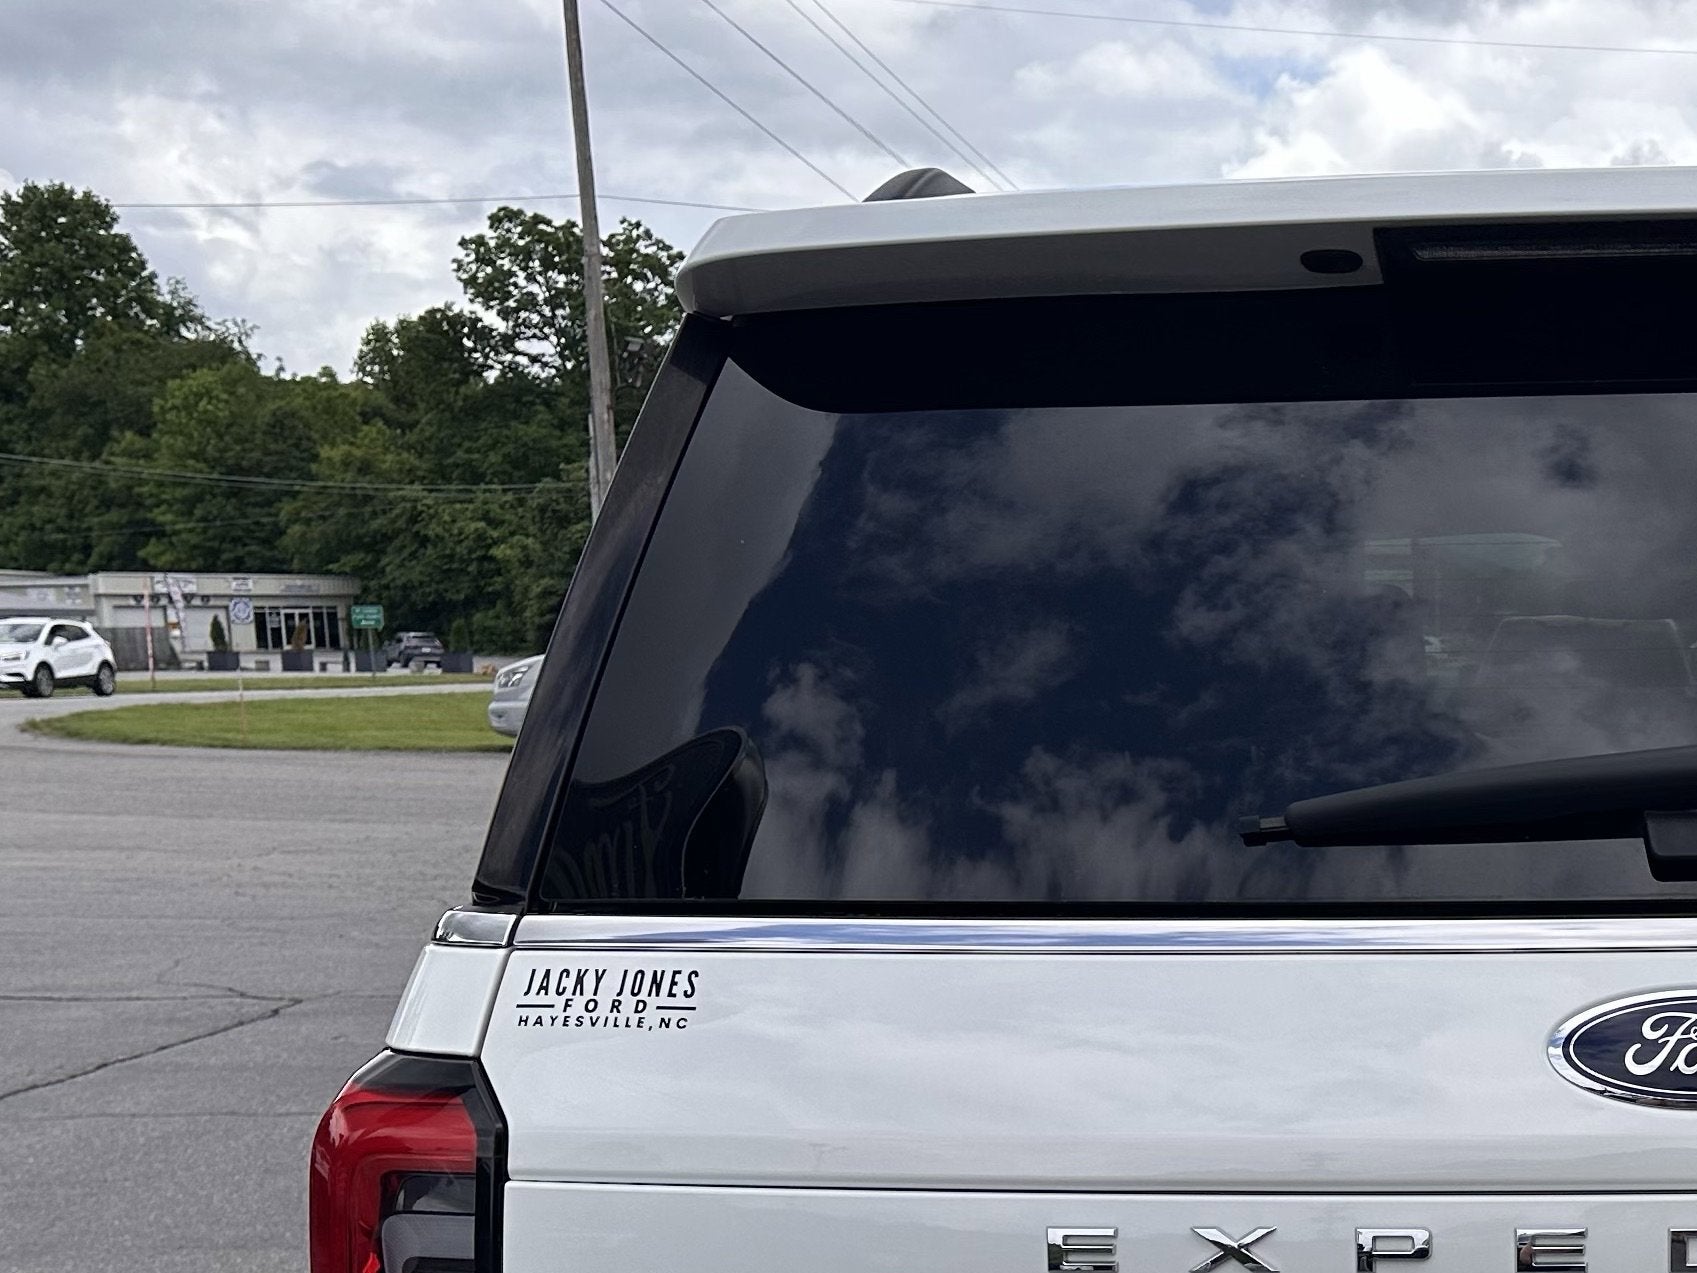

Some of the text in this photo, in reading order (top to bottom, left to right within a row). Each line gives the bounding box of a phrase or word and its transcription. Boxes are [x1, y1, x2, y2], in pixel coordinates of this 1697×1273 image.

[523, 968, 699, 999] JACKY JONES
[563, 998, 647, 1014] FORD
